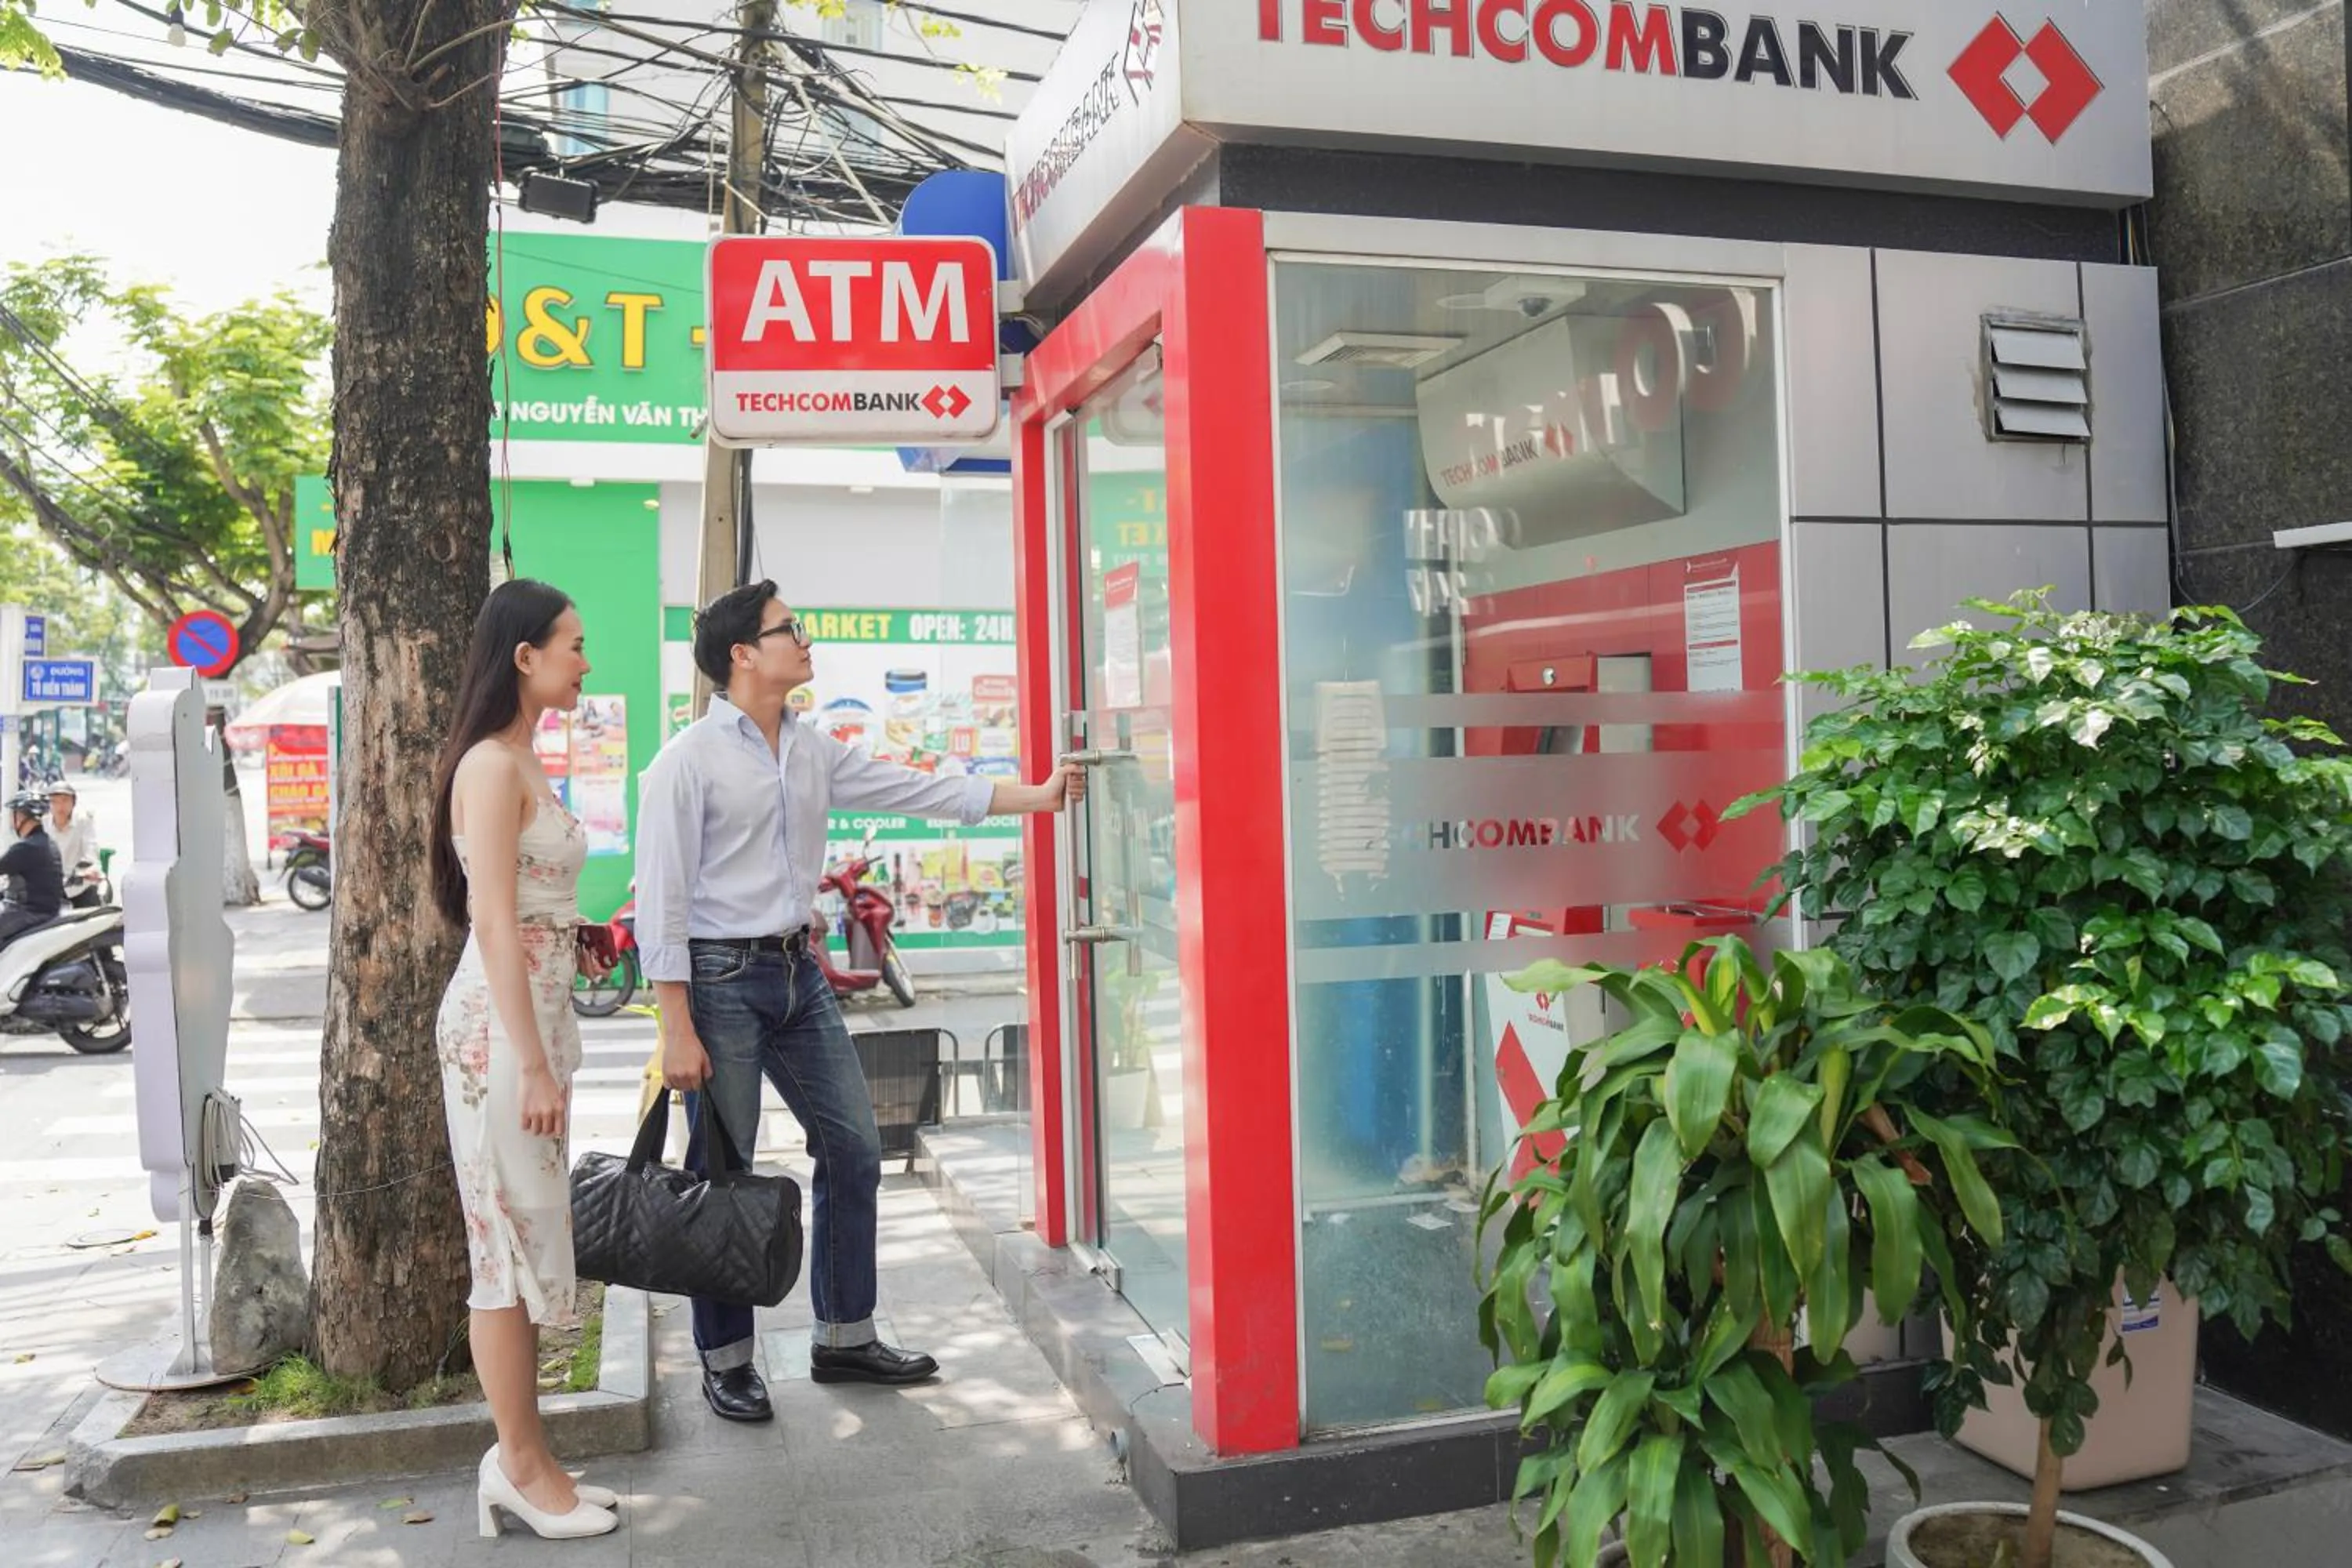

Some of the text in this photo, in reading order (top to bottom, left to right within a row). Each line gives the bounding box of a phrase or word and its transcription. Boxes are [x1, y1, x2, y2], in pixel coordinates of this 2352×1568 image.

[742, 260, 970, 343] ATM
[510, 394, 616, 425] NGUYỄN
[622, 401, 672, 426] VĂN
[736, 392, 921, 412] TECHCOMBANK
[1440, 437, 1540, 488] TECHOMANK
[794, 612, 892, 639] ARKET
[909, 613, 966, 641] OPEN:
[1405, 814, 1640, 850] HCOMBANK
